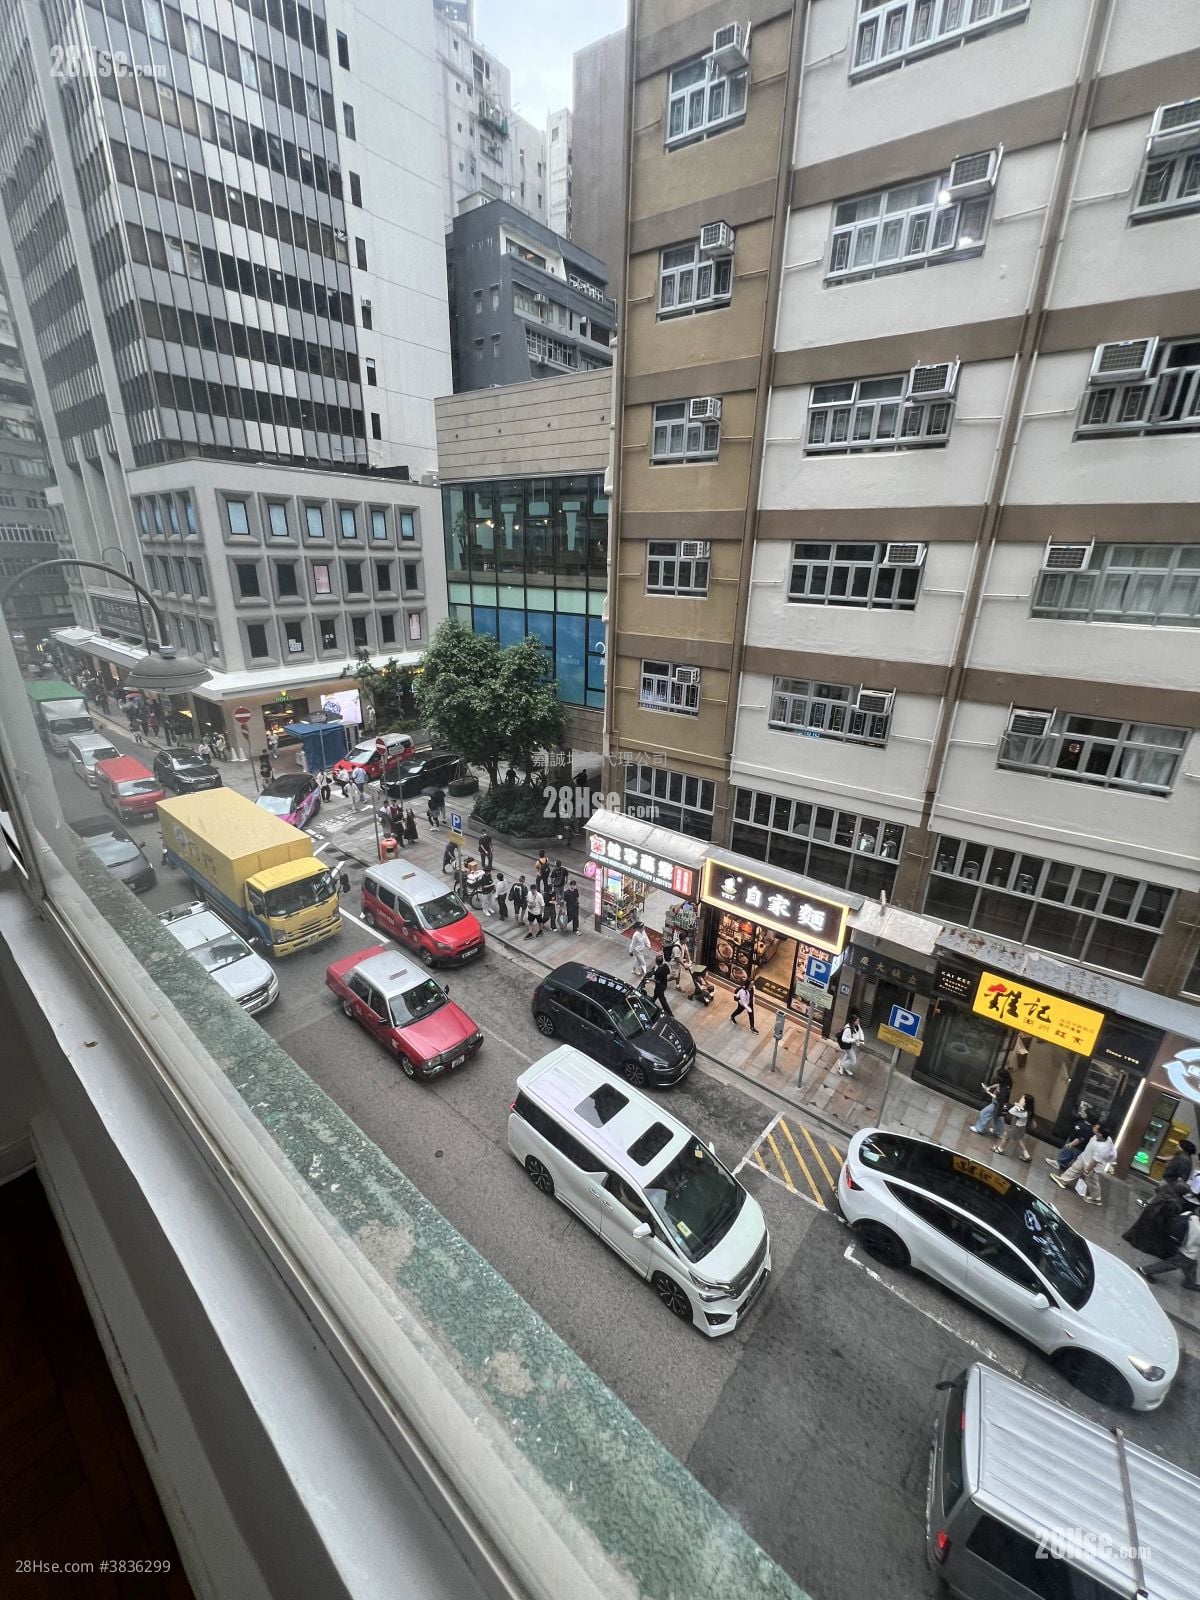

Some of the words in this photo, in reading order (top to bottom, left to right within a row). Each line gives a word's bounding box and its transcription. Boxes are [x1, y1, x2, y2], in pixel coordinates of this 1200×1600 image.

[745, 885, 825, 931] 自家麵
[809, 959, 826, 976] P
[941, 971, 955, 979] KAI
[957, 975, 971, 985] KEE
[893, 1008, 914, 1028] P
